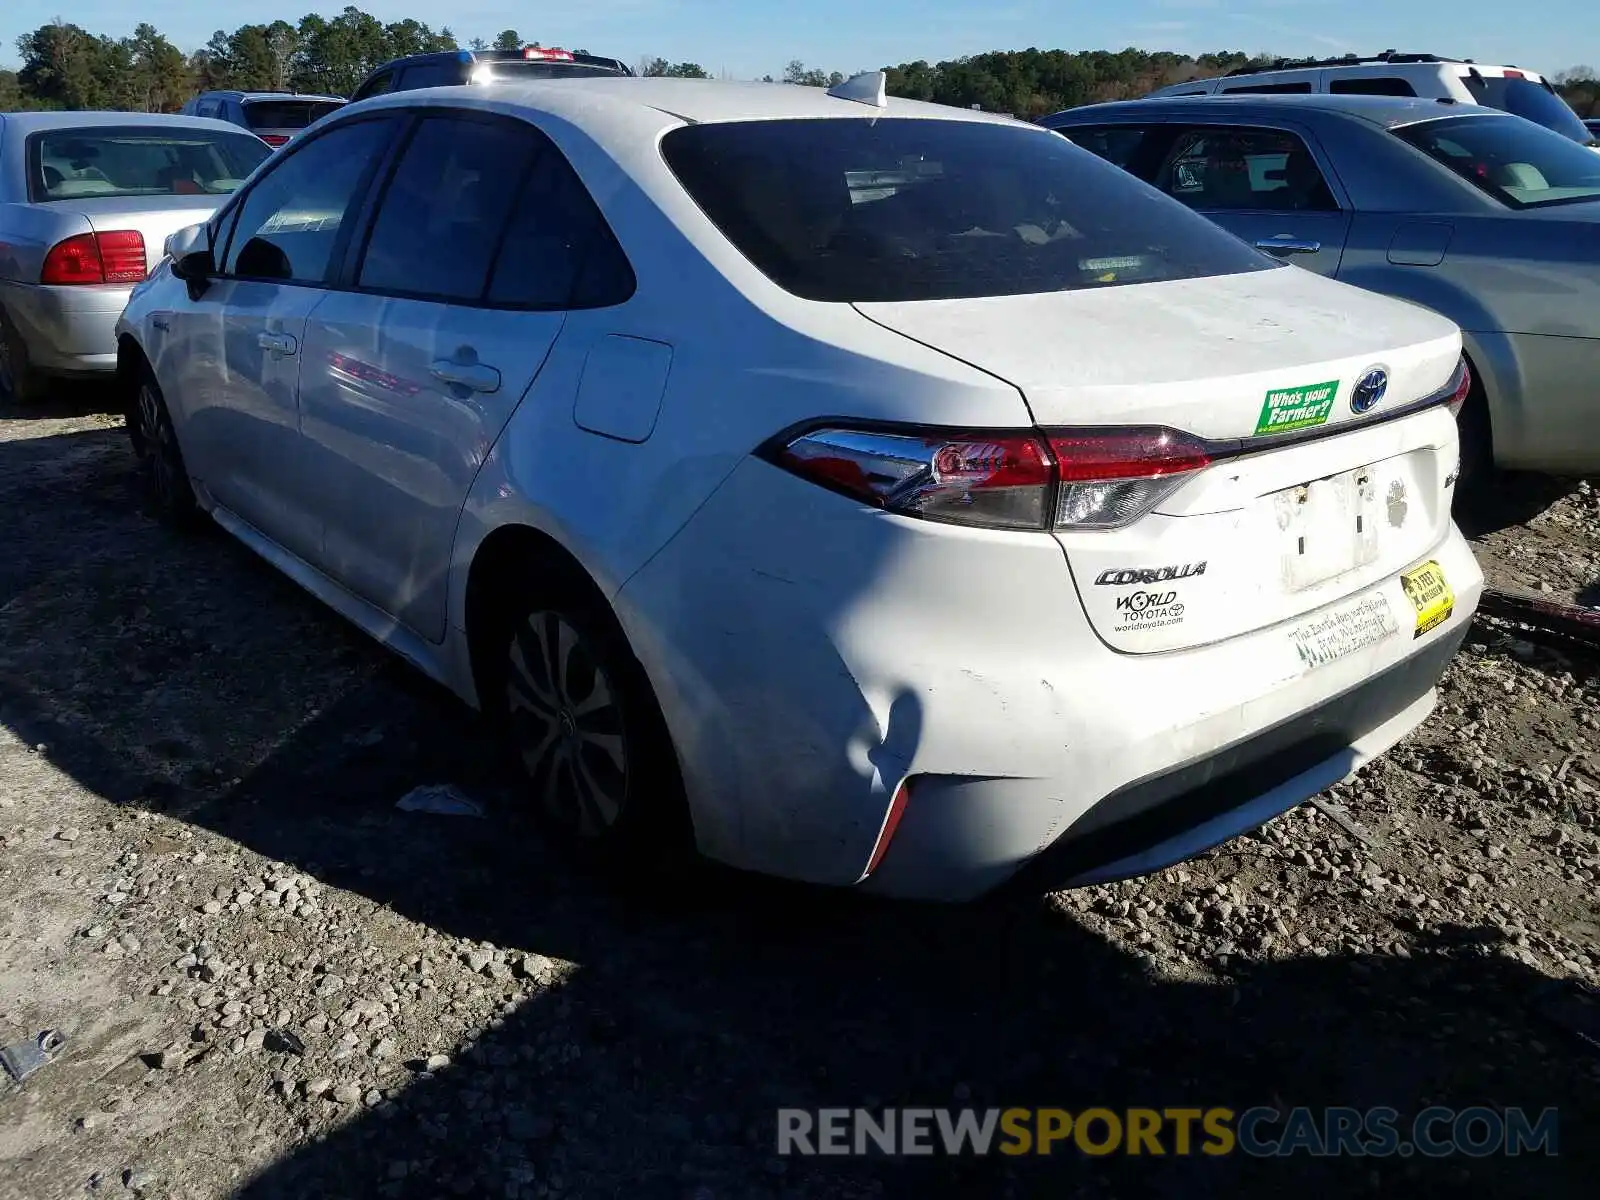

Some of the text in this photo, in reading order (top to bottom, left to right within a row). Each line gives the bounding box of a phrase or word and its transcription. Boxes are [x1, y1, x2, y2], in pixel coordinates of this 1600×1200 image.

[1268, 387, 1332, 409] Who's your
[1268, 400, 1331, 425] Farmer?
[1094, 560, 1208, 586] COROLLA
[1418, 570, 1436, 589] FEET
[1116, 590, 1177, 612] WORLD
[1114, 617, 1184, 633] worldtoyota.com
[1123, 608, 1167, 622] TOYOTA
